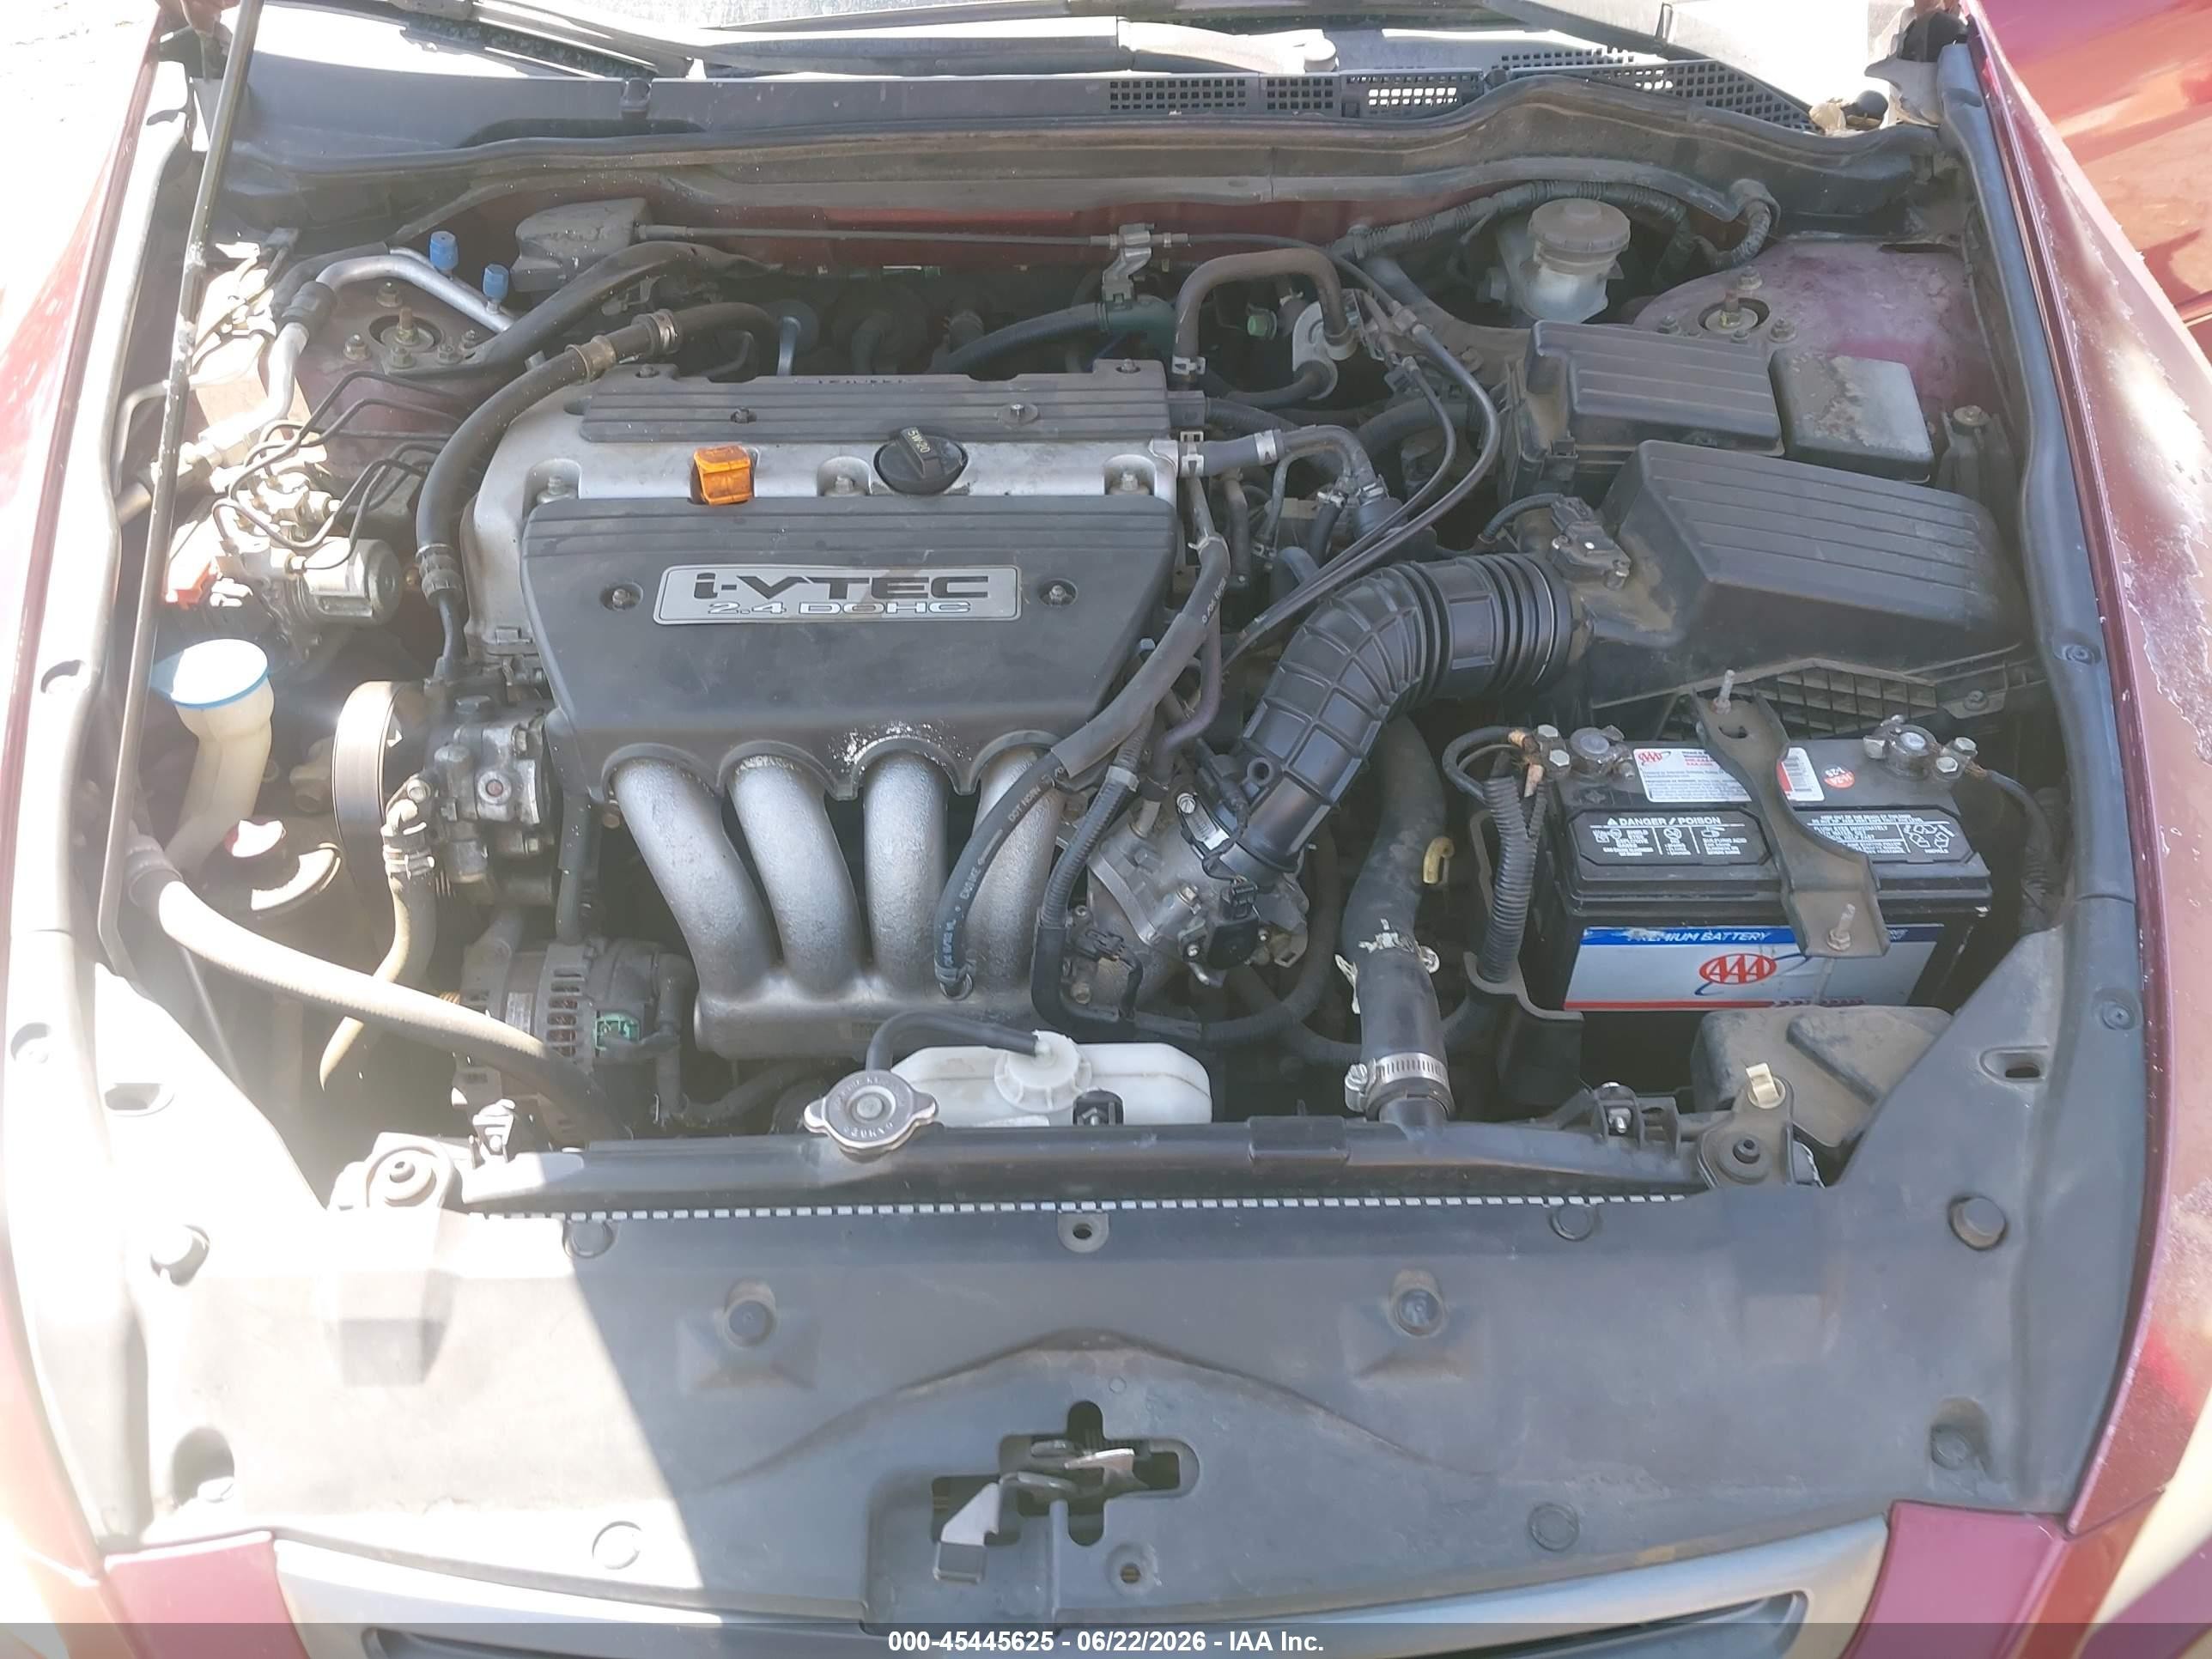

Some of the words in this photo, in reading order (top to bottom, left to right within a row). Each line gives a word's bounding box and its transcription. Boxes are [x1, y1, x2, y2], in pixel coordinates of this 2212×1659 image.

[908, 429, 931, 453] 5W-20
[693, 573, 989, 600] i-VTEC
[708, 600, 787, 616] 2.4
[798, 600, 971, 616] DOHC
[1619, 817, 1667, 825] DANGER
[1677, 816, 1722, 825] POISON
[1701, 930, 1770, 942] BATTERY
[1704, 954, 1771, 984] AAA
